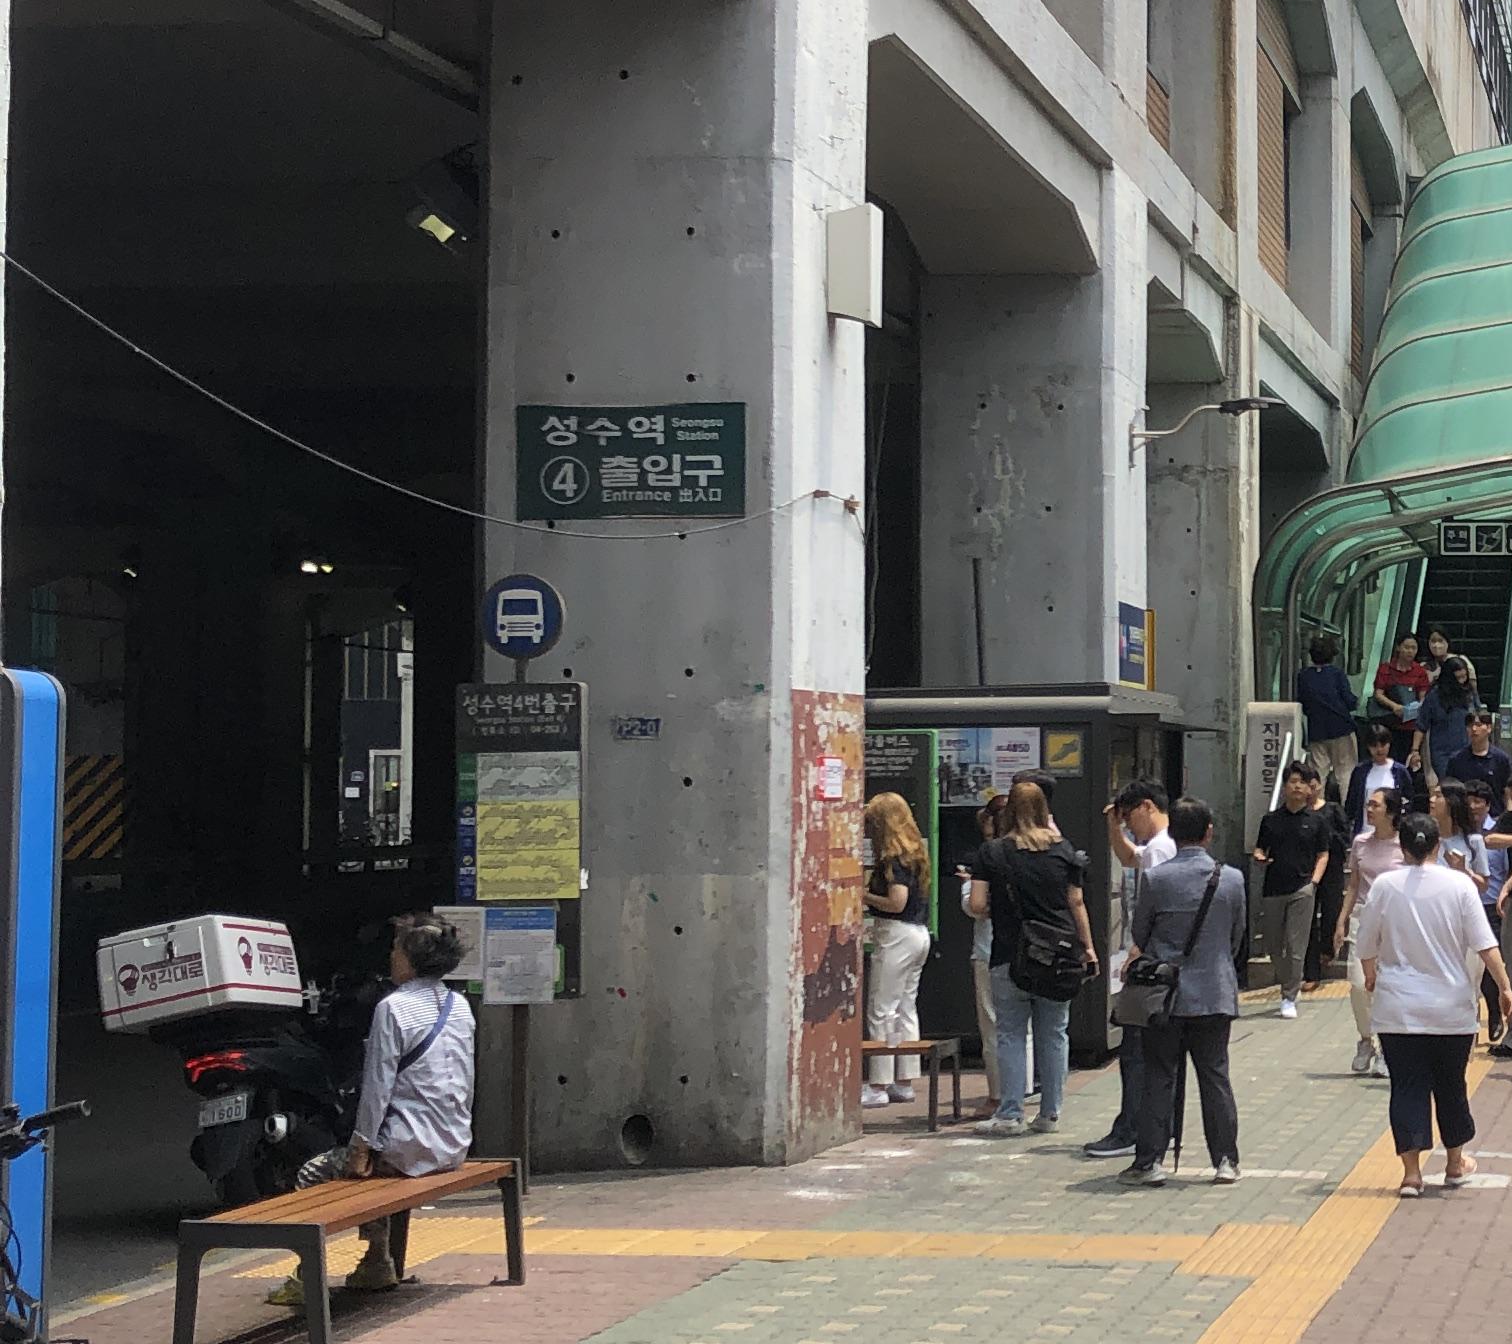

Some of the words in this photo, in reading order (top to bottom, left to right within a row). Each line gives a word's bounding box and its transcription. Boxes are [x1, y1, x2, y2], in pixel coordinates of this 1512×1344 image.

[540, 414, 664, 446] 성수역
[671, 417, 724, 430] Seongsu
[676, 430, 719, 441] Station
[552, 462, 578, 498] 4
[600, 454, 724, 487] 출입구
[601, 489, 672, 503] Entrance
[679, 488, 722, 503] 出入口
[462, 692, 577, 716] 성수역4번출구
[142, 960, 204, 992] 생각대로
